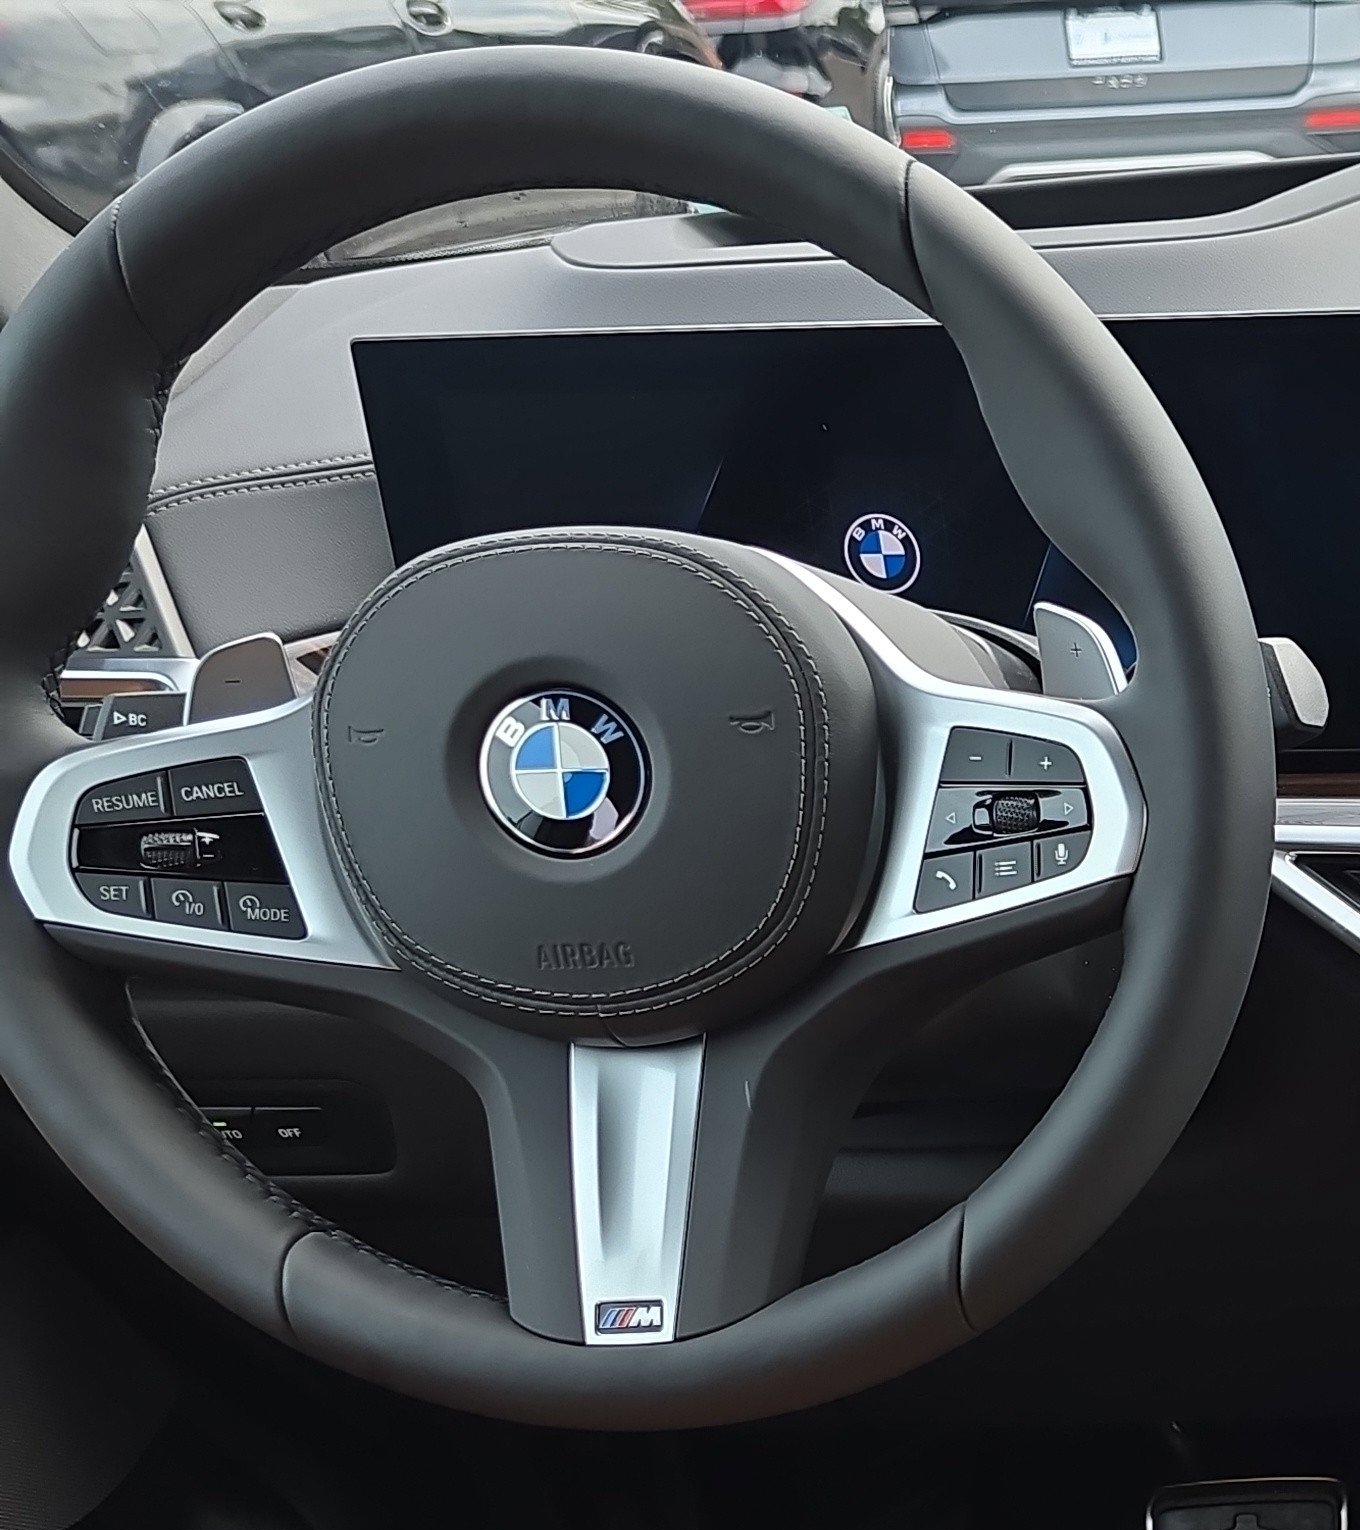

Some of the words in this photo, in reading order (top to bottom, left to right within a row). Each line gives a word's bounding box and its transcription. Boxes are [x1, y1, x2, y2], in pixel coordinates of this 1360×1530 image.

[853, 518, 906, 541] BMW
[128, 713, 147, 726] BC
[495, 697, 624, 747] BMW
[92, 792, 159, 813] RESUME
[181, 782, 244, 802] CANCEL
[100, 886, 129, 901] SET
[247, 909, 290, 922] MODE
[538, 941, 635, 971] AIRBAG
[278, 1128, 301, 1138] OFF
